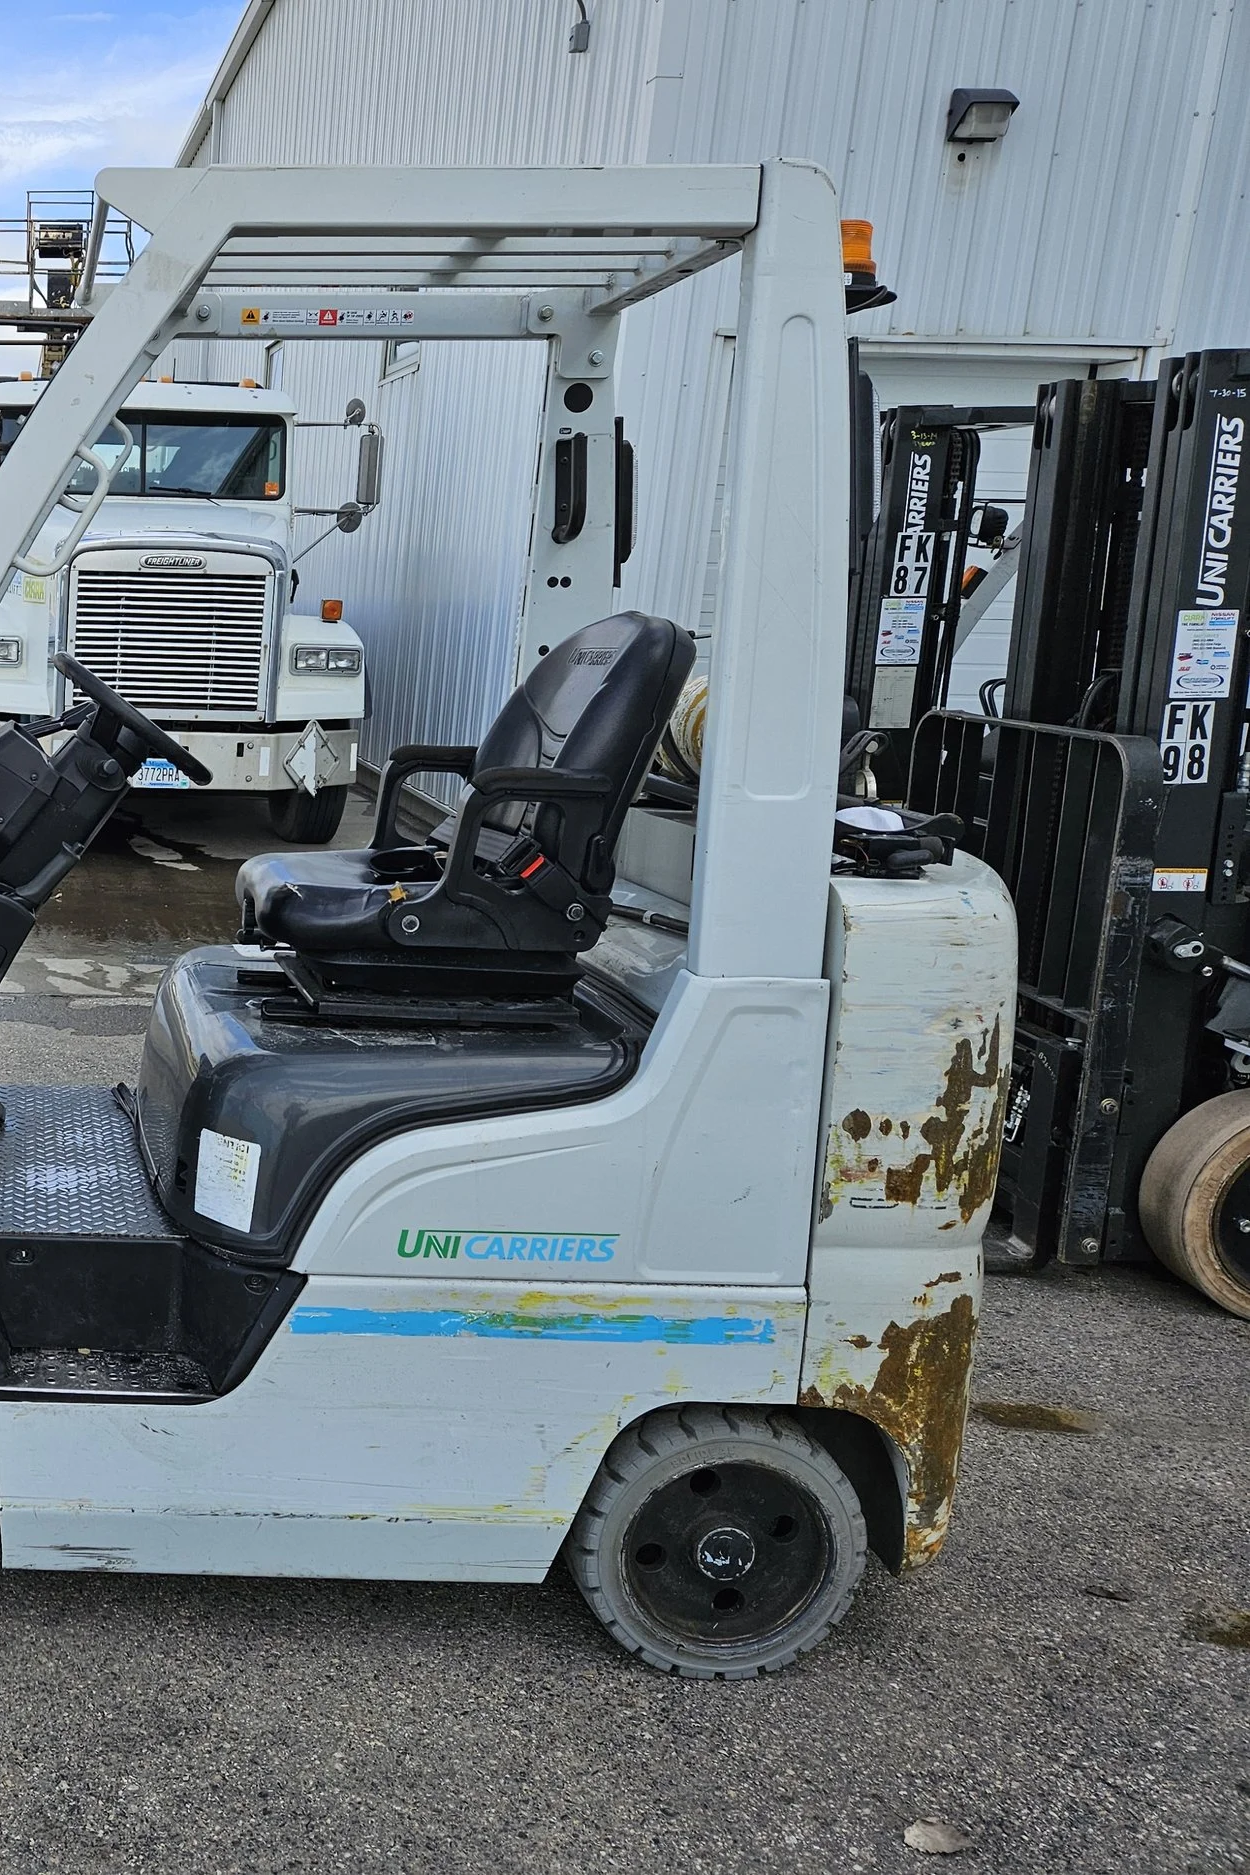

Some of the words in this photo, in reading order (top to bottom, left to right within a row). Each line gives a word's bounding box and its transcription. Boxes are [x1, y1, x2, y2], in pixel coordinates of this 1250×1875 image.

[907, 453, 932, 532] ARRIERS
[1195, 415, 1245, 606] UNICARRIERS
[146, 557, 200, 566] FREIGHTLINER
[898, 535, 932, 563] FK
[893, 565, 928, 594] 87
[1166, 704, 1212, 740] FK
[1163, 744, 1205, 781] 98
[397, 1229, 619, 1263] UNICARRIERS
